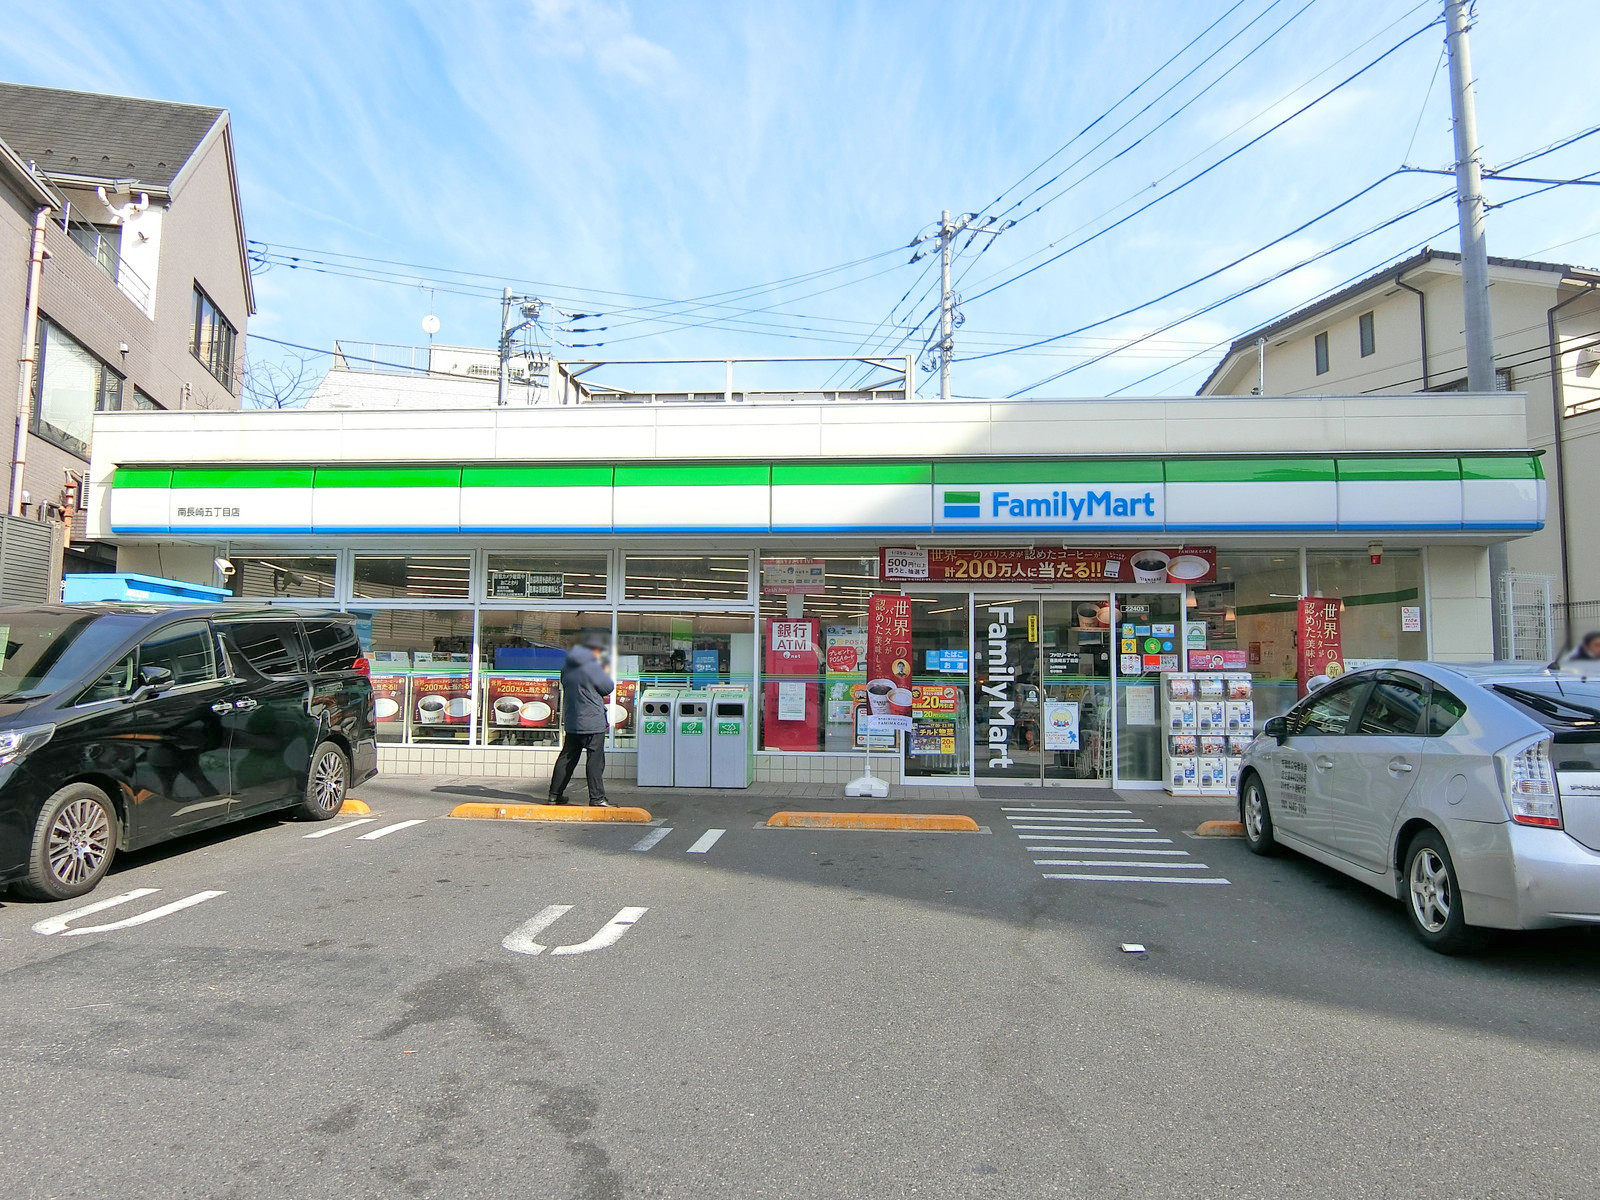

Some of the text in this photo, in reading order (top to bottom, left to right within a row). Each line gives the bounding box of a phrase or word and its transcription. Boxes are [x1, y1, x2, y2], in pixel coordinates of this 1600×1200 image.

[178, 507, 240, 517] 南長崎五丁目店
[993, 491, 1155, 520] FamilyMart
[931, 549, 1101, 562] 世界一のバリスタが認めたコーヒーが
[945, 559, 1101, 578] 計200万人に当たる!!
[777, 623, 807, 638] 銀行
[885, 607, 894, 655] バリスタが
[893, 600, 910, 658] 世界一の
[1315, 610, 1324, 658] バリスタが
[1323, 603, 1339, 661] 世界一の
[777, 640, 806, 649] ATM
[981, 606, 1014, 769] FamilyMart
